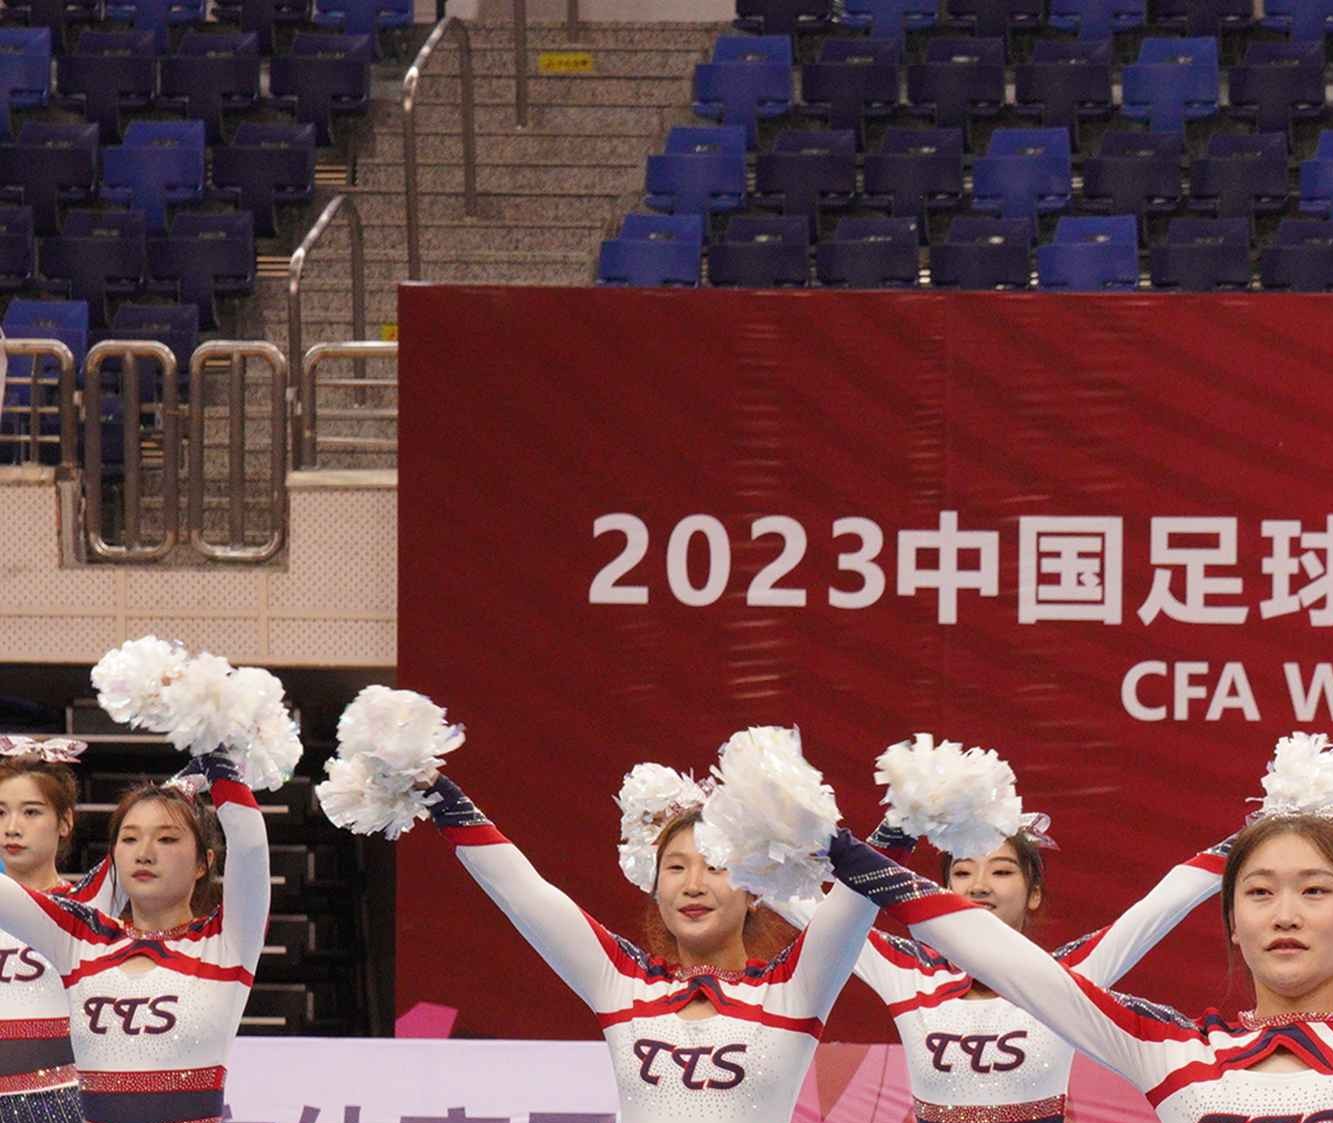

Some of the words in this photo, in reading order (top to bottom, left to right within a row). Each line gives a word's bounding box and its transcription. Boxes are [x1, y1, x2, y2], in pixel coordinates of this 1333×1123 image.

[1120, 661, 1260, 722] CFA
[83, 995, 178, 1035] TTS
[633, 1038, 746, 1090] TTS
[924, 1031, 1027, 1073] TTS
